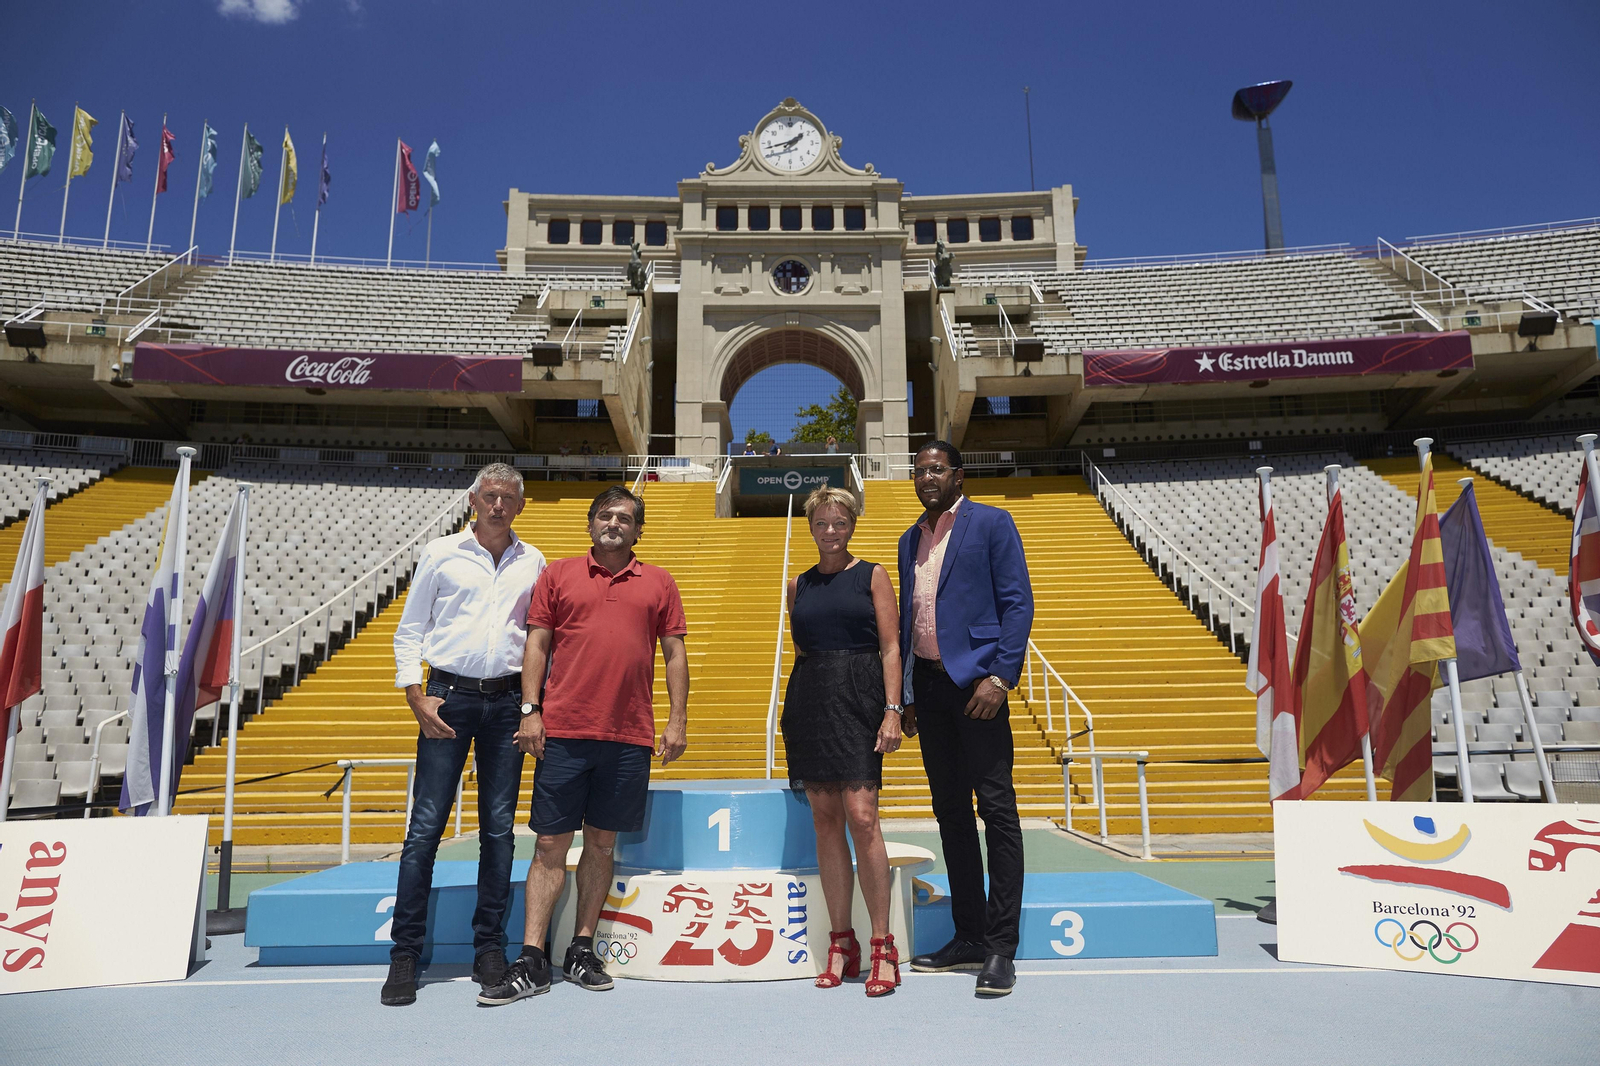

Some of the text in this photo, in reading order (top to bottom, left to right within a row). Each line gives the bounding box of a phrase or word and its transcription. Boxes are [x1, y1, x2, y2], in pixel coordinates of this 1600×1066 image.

[409, 182, 417, 207] OPEN
[285, 355, 376, 384] Coca-Cola
[1218, 349, 1354, 372] Estrella Damm
[757, 476, 829, 485] OPEN CAMP
[708, 808, 730, 852] 1
[0, 841, 67, 972] anys
[1372, 901, 1450, 917] Barcelona
[597, 930, 627, 940] Barcelona
[658, 883, 774, 966] 25
[779, 881, 808, 964] anys
[1050, 910, 1085, 956] 3
